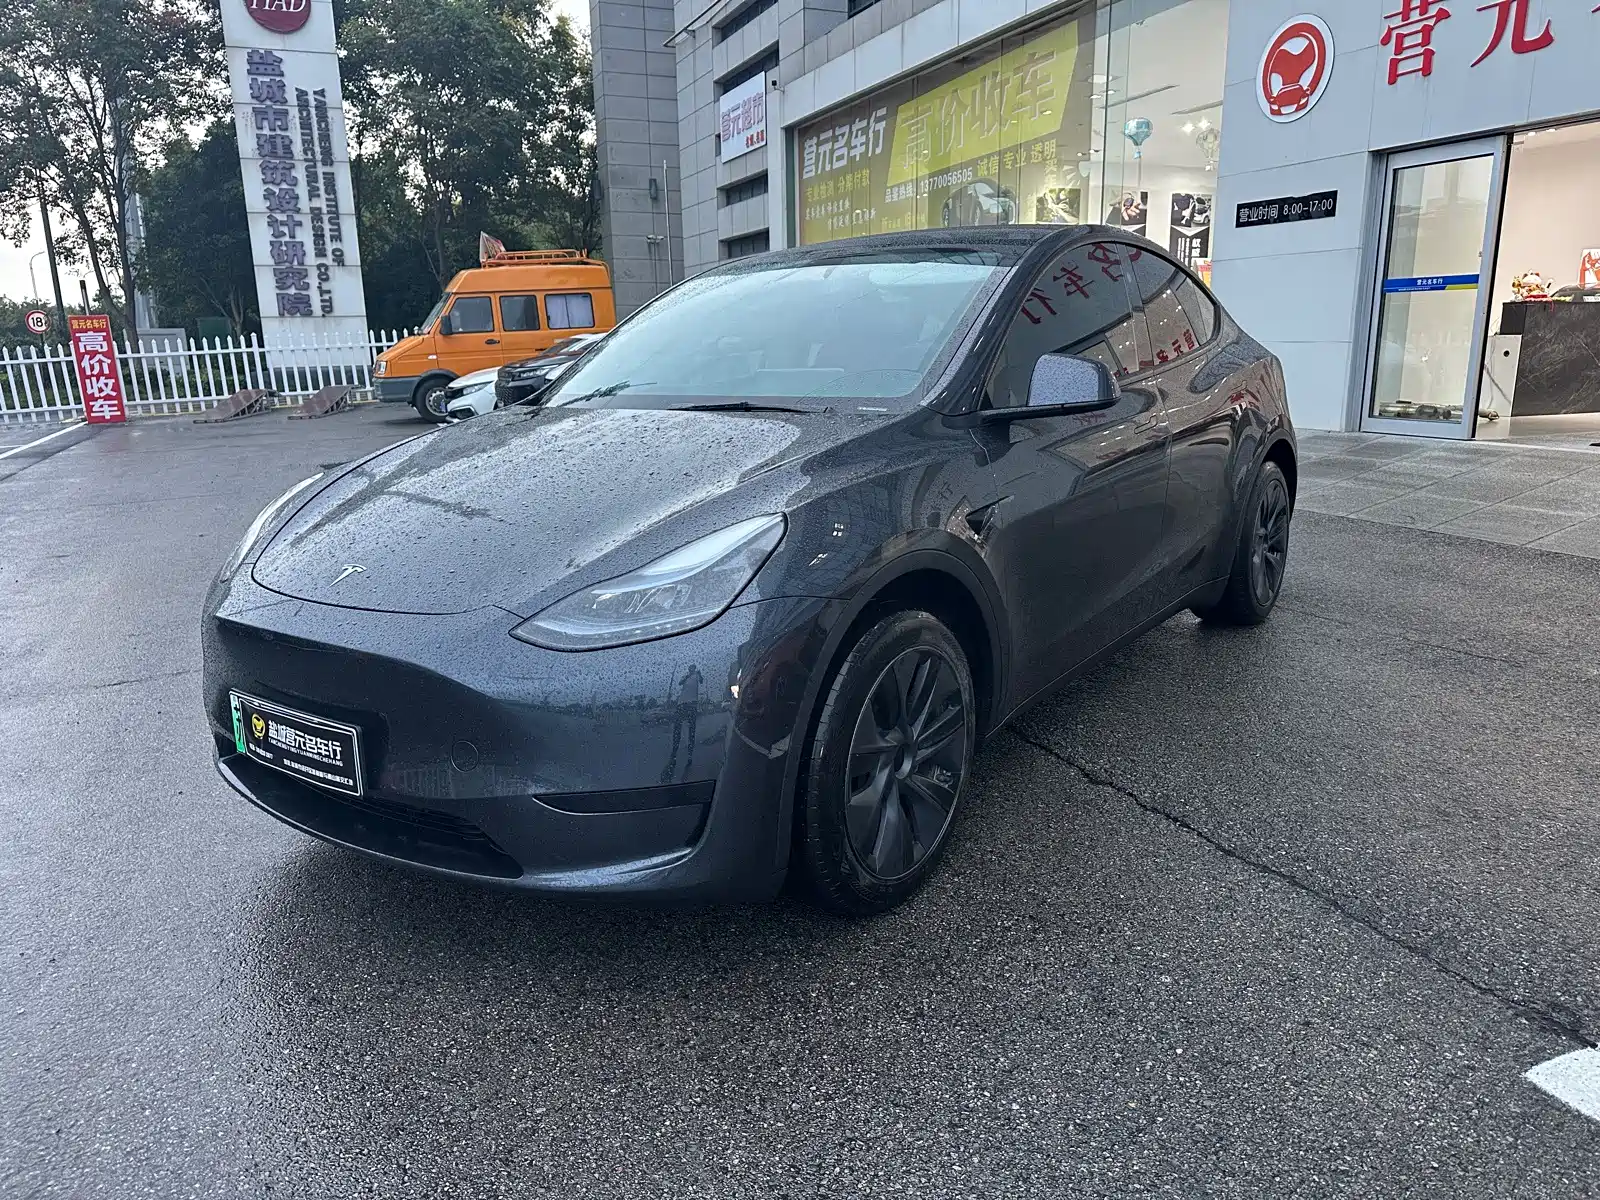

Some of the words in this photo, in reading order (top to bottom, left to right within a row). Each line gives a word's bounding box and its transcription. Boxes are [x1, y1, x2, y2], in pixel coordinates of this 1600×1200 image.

[1380, 0, 1600, 85] 营元
[313, 88, 334, 167] YANCHENG
[721, 92, 764, 142] 营元超市
[802, 106, 888, 180] 营元名车行
[900, 50, 1057, 169] 高价收车
[247, 50, 313, 317] 盐城市建筑设计研究院
[295, 87, 321, 202] ARCHITECTURAL
[310, 206, 327, 258] DESIGN
[919, 166, 973, 194] 13770056505
[976, 156, 1000, 178] 诚信
[1003, 147, 1027, 170] 专业
[1031, 138, 1057, 164] 透明
[322, 171, 342, 243] INSTITUTE
[1239, 206, 1278, 223] 营业时间
[1283, 199, 1334, 216] 8:00-17:00
[331, 247, 345, 267] OF
[72, 319, 107, 329] 营元名车行
[75, 331, 121, 420] 高价收车
[268, 719, 342, 760] 盐城营元名车行
